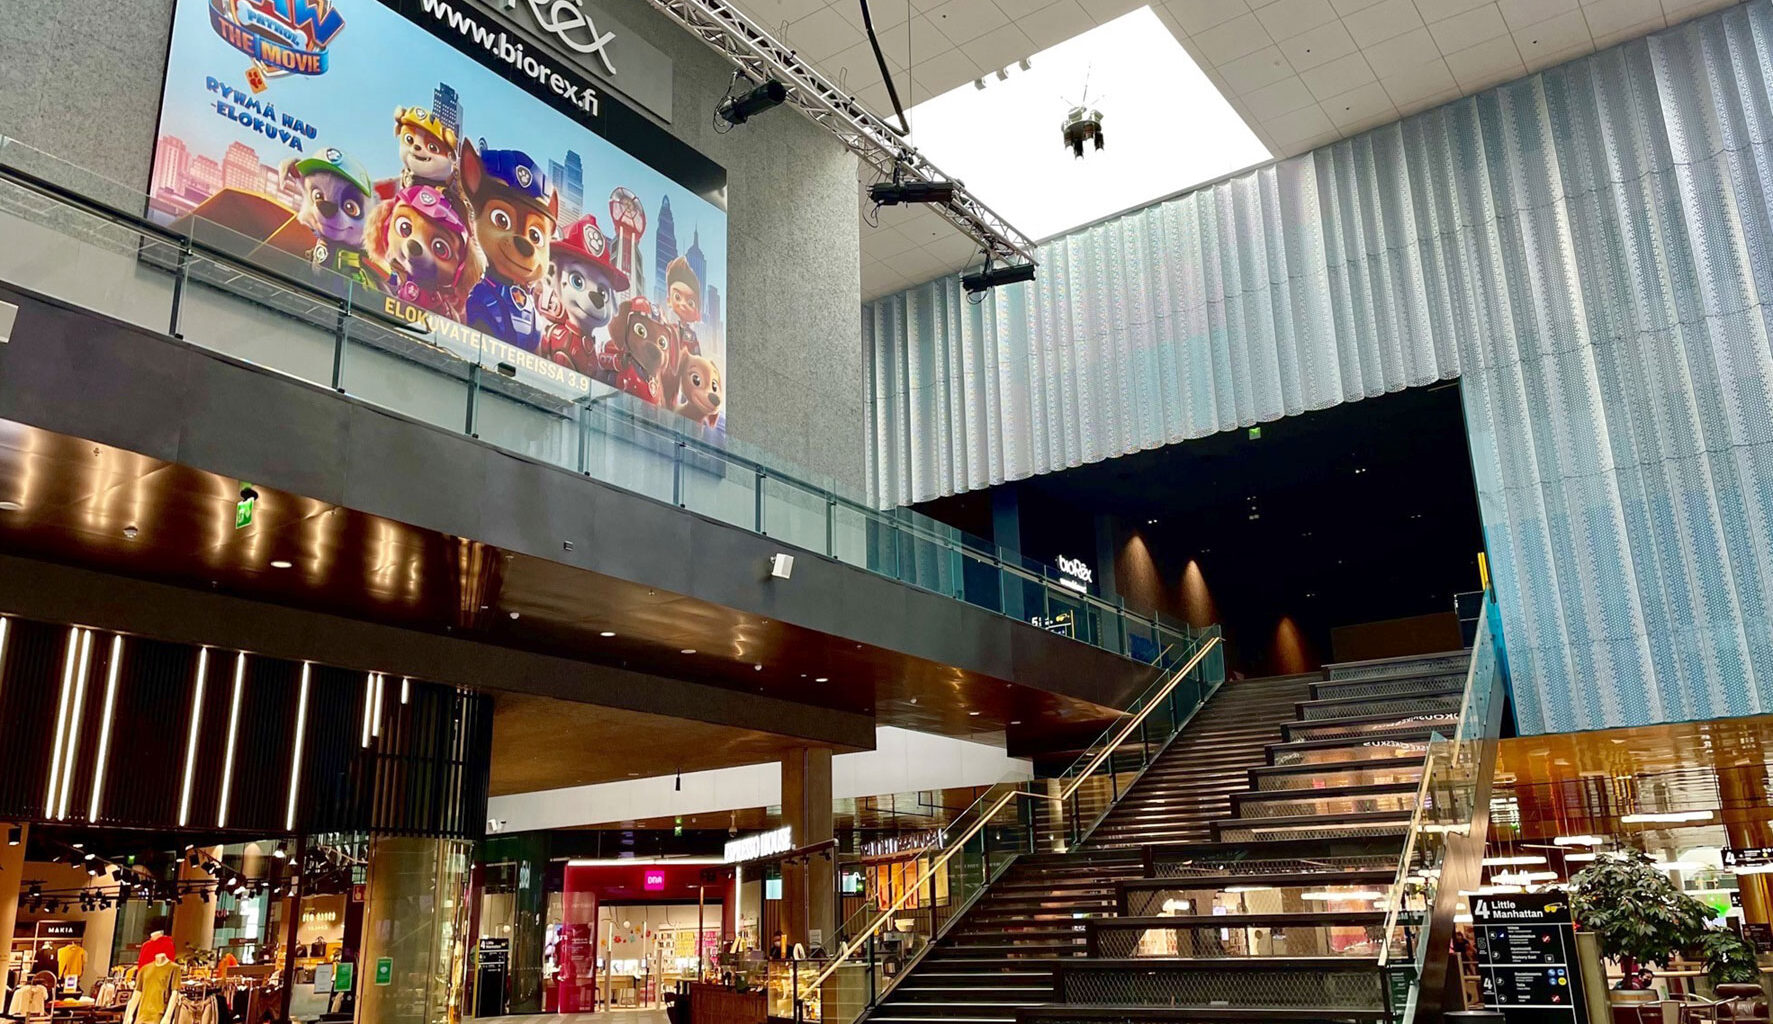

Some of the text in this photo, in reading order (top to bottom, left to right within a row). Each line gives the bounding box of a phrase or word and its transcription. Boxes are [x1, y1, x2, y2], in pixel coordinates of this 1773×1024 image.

[218, 17, 321, 73] THE MOVIE
[206, 76, 277, 122] RYHMÄ
[384, 296, 589, 392] ELOKUVATEATTEREISSA 3.9
[1725, 851, 1737, 865] 4
[647, 876, 662, 884] DNA
[1475, 899, 1516, 919] 4 Little
[1493, 910, 1544, 919] Manhattan
[1483, 977, 1493, 989] 4
